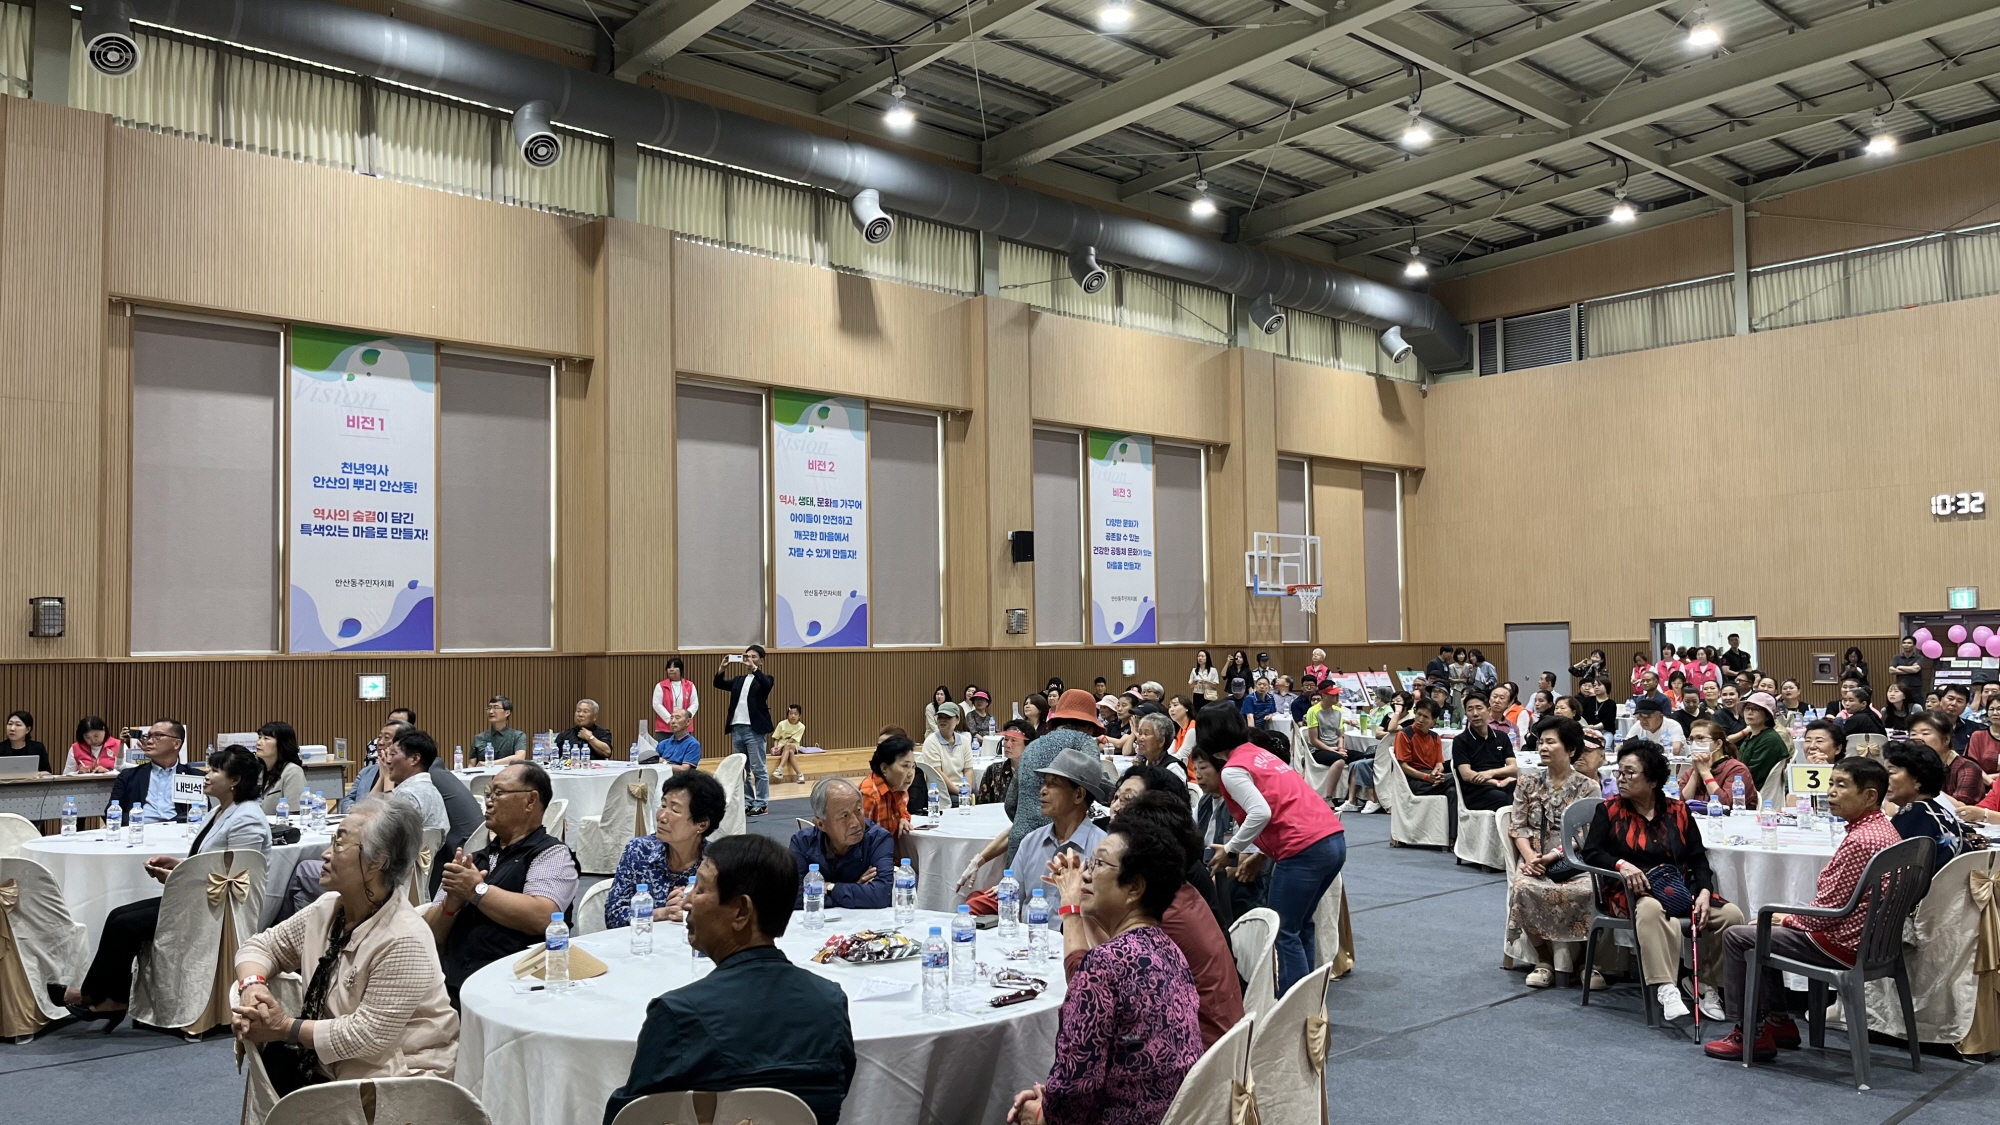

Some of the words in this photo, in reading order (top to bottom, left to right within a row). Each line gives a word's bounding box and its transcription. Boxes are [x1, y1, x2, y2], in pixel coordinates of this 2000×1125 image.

[293, 379, 376, 407] Vision
[346, 415, 375, 430] 비전
[378, 418, 385, 431] 1
[776, 431, 829, 454] Vision
[341, 461, 390, 476] 천년역사
[808, 459, 827, 472] 비전
[828, 461, 836, 473] 2
[312, 476, 350, 490] 안산의
[352, 478, 377, 491] 뿌리
[379, 480, 418, 494] 안산동!
[1112, 487, 1126, 498] 비전
[1126, 489, 1132, 498] 3
[779, 494, 797, 506] 역사,
[798, 496, 816, 507] 생태,
[816, 497, 839, 508] 문화를
[839, 499, 862, 510] 가꾸어
[1930, 491, 1985, 516] 10:32
[312, 508, 350, 521] 역사의
[352, 510, 388, 523] 숨결이
[391, 512, 414, 525] 담긴
[790, 513, 821, 524] 아이들이
[822, 514, 853, 526] 안전하고
[300, 524, 350, 538] 특색있는
[352, 526, 388, 539] 마을로
[390, 527, 429, 541] 만들자!
[794, 530, 818, 541] 깨끗한
[819, 532, 850, 543] 마을에서
[1122, 533, 1128, 542] 수
[788, 547, 805, 558] 자랄
[805, 548, 814, 558] 수
[815, 548, 831, 559] 있게
[832, 549, 857, 560] 만들자!
[1093, 546, 1110, 555] 건강한
[334, 578, 395, 588] 안산동주민자치회
[1806, 770, 1821, 789] 3
[175, 781, 202, 795] 내빈석
